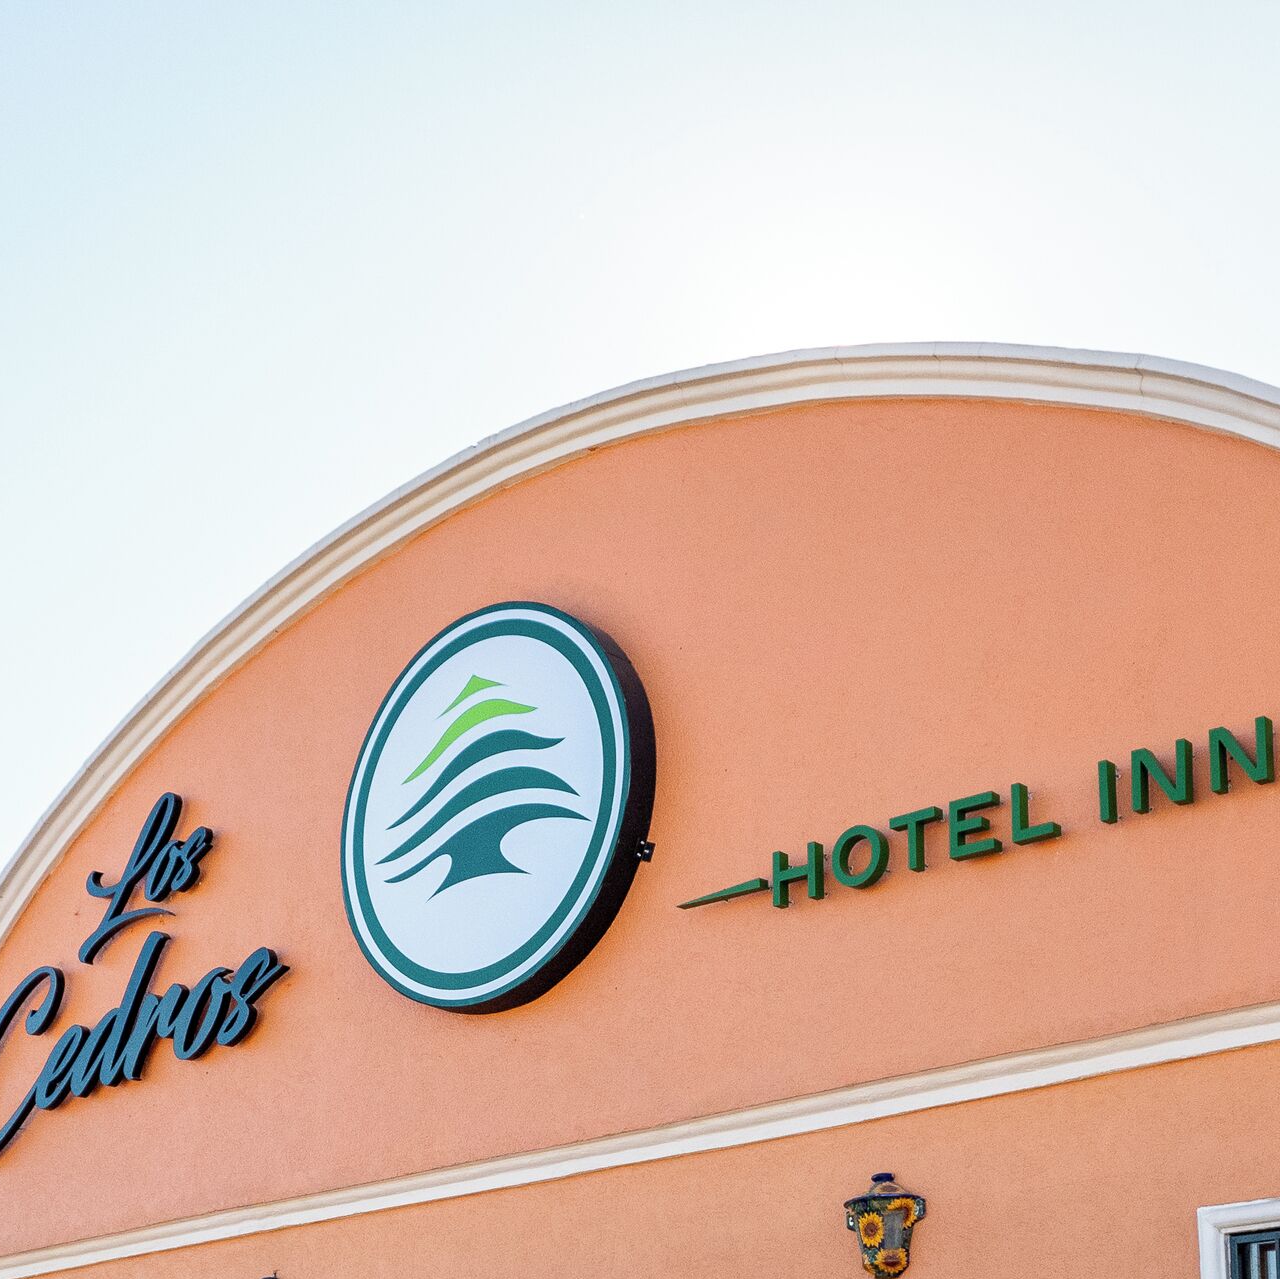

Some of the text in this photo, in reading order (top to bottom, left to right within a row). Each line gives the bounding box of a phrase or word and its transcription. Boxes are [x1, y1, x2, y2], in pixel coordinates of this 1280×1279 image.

[78, 791, 214, 966] Los
[772, 715, 1276, 909] HOTEL INN
